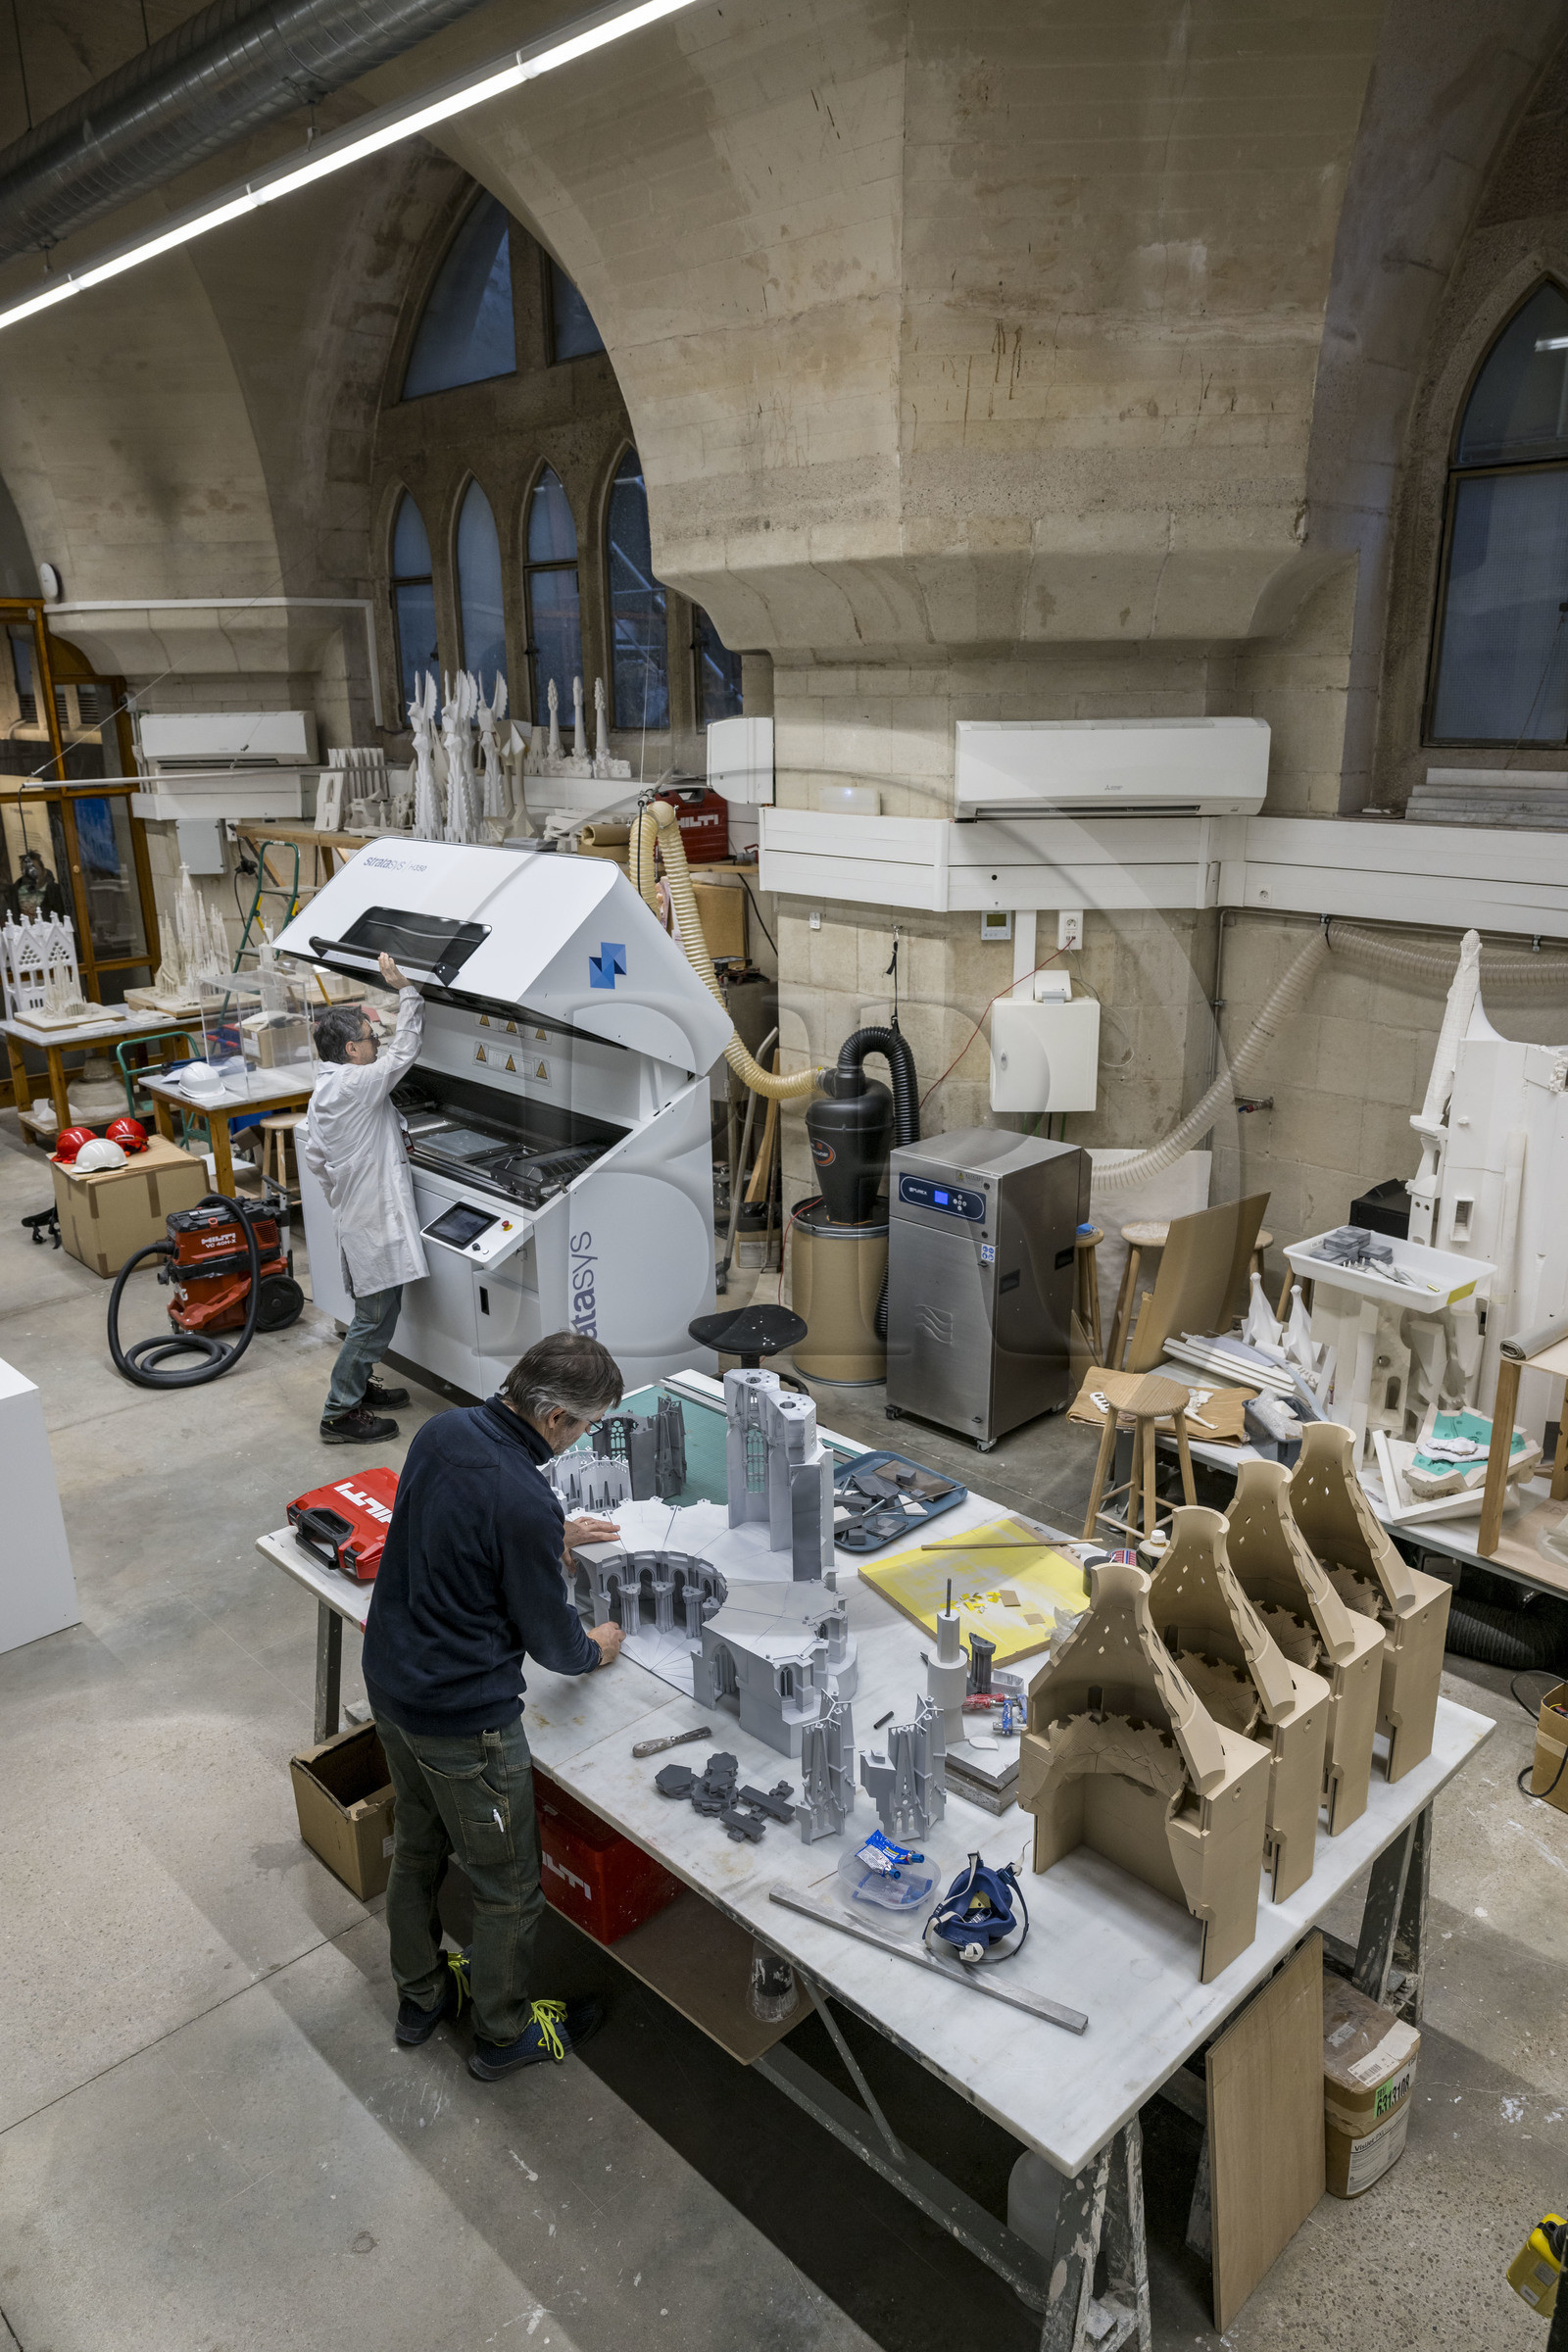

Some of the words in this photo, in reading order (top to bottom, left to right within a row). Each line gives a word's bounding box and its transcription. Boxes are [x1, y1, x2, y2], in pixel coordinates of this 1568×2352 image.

[364, 857, 407, 870] stratasys
[201, 1233, 236, 1245] HILTI
[205, 1240, 215, 1249] VC
[569, 1231, 598, 1341] atasys
[542, 1850, 592, 1901] ILTI
